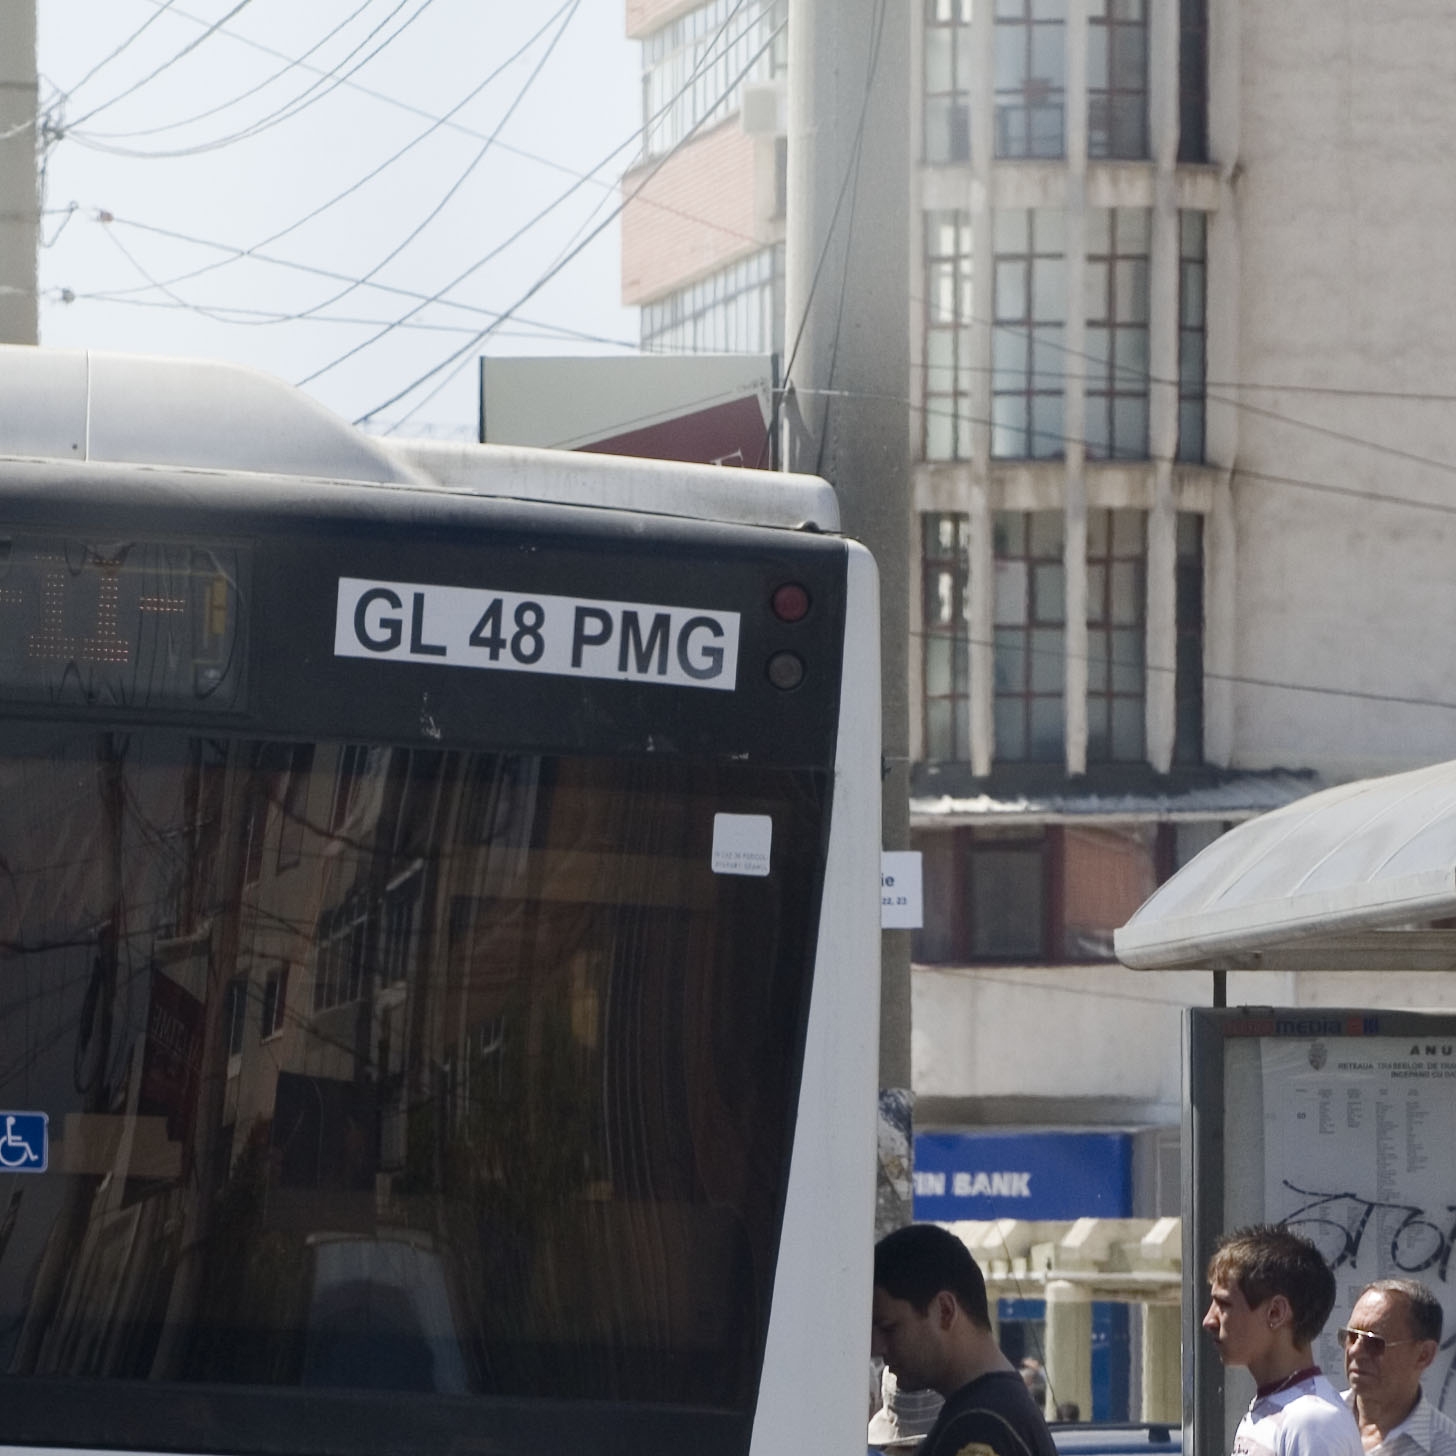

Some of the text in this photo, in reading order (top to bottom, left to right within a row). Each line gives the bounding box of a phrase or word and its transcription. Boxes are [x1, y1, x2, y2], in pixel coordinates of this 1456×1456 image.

[353, 587, 725, 680] GL 48 PMG
[952, 1172, 1031, 1197] BANK
